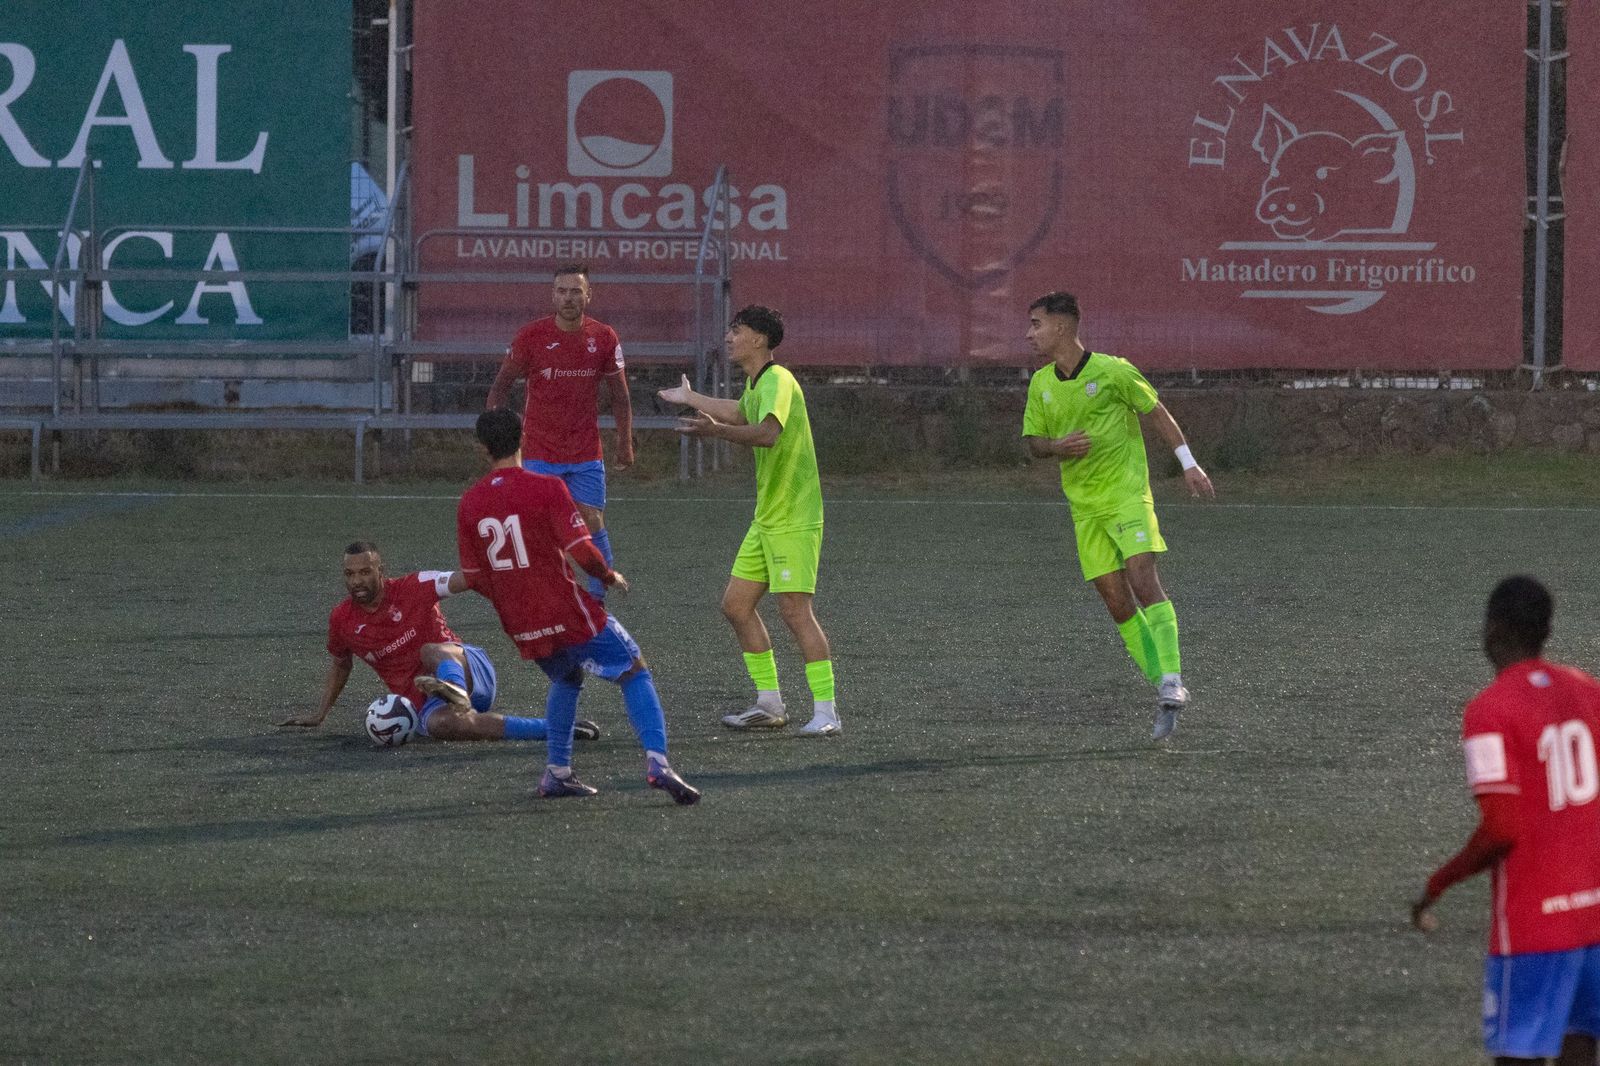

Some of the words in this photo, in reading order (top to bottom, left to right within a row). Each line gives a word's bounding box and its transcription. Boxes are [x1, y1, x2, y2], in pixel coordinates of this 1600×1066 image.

[0, 39, 269, 174] RAL
[1188, 105, 1235, 170] EL
[1212, 22, 1427, 104] NAVAZO
[458, 154, 788, 230] Limcasa
[0, 230, 263, 326] NCA
[457, 238, 611, 259] LAVANDERIA
[1181, 258, 1316, 283] Matadero
[1327, 258, 1476, 289] Frigorífico
[477, 514, 530, 571] 21
[1537, 719, 1599, 812] 10
